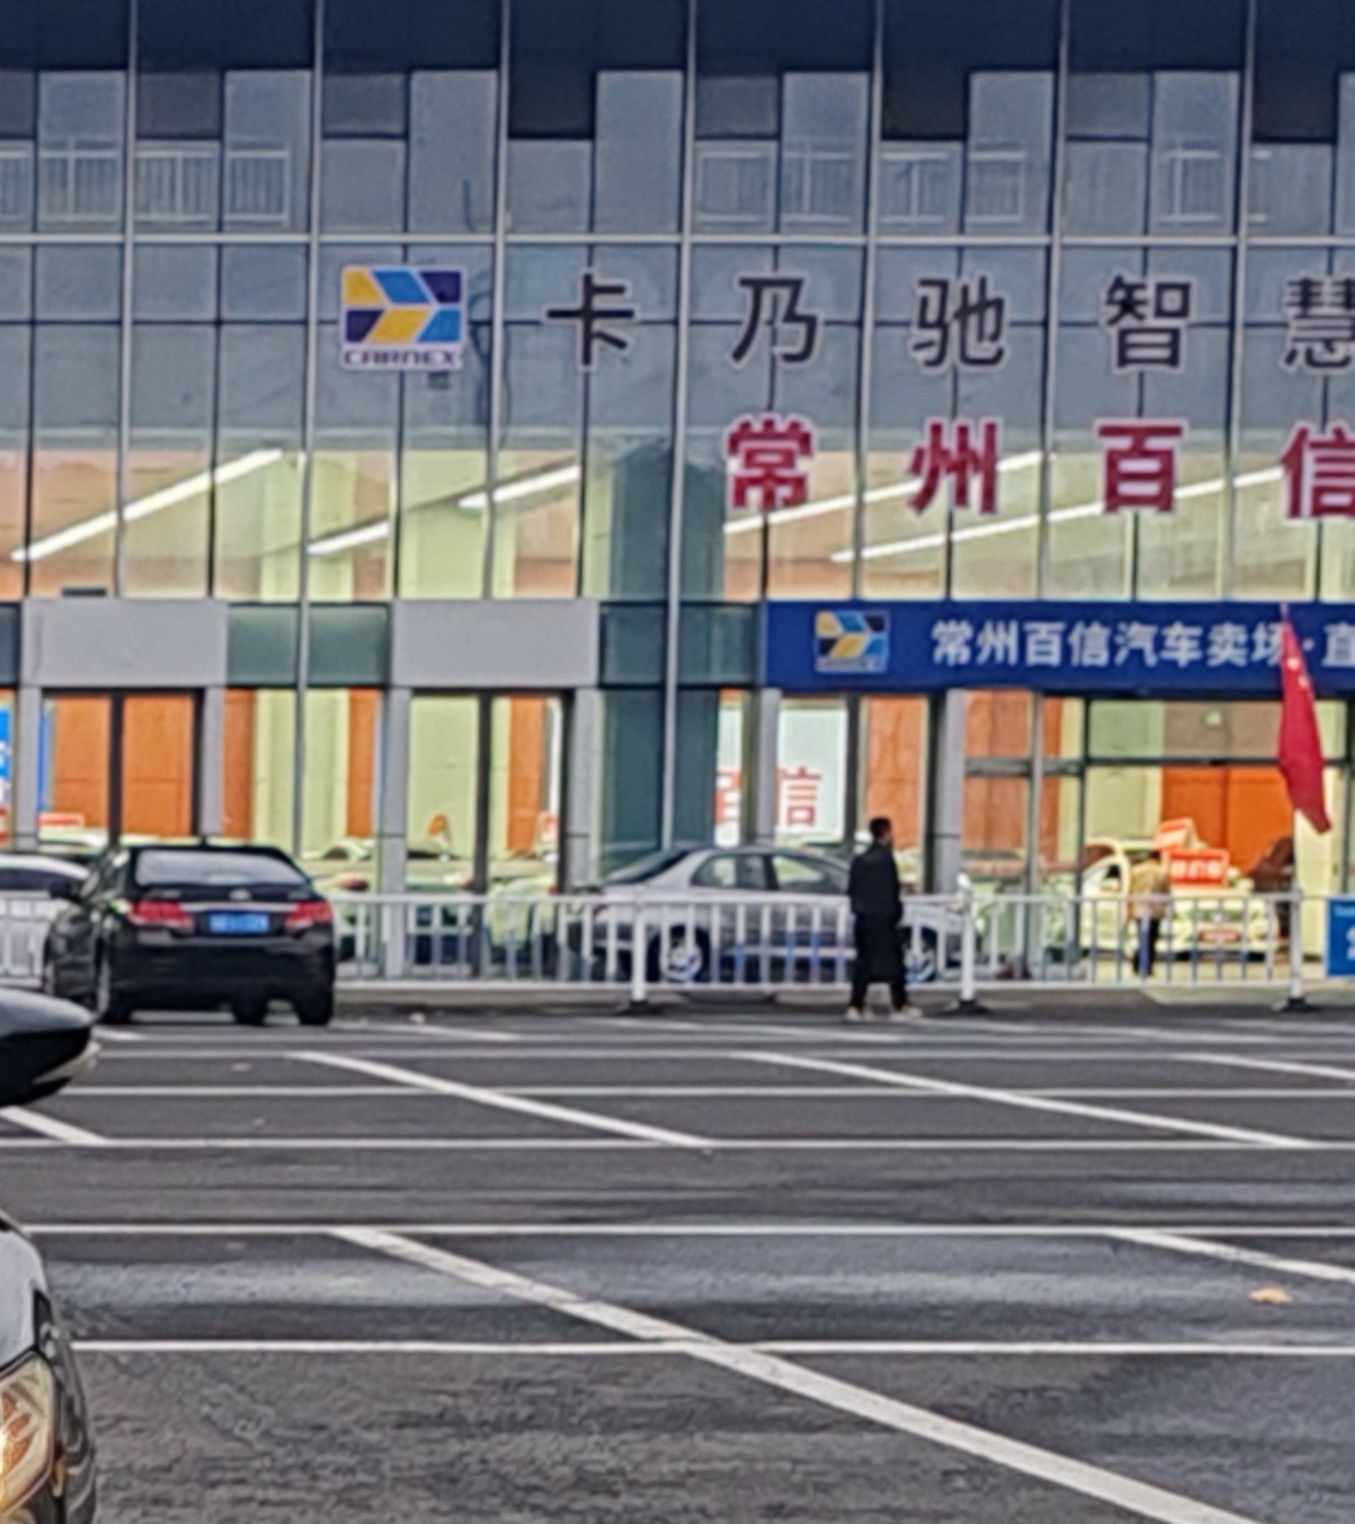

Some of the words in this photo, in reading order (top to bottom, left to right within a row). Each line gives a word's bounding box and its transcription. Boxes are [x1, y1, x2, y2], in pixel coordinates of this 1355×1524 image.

[544, 271, 1355, 371] 卡乃驰智慧
[725, 416, 1355, 520] 常州百信
